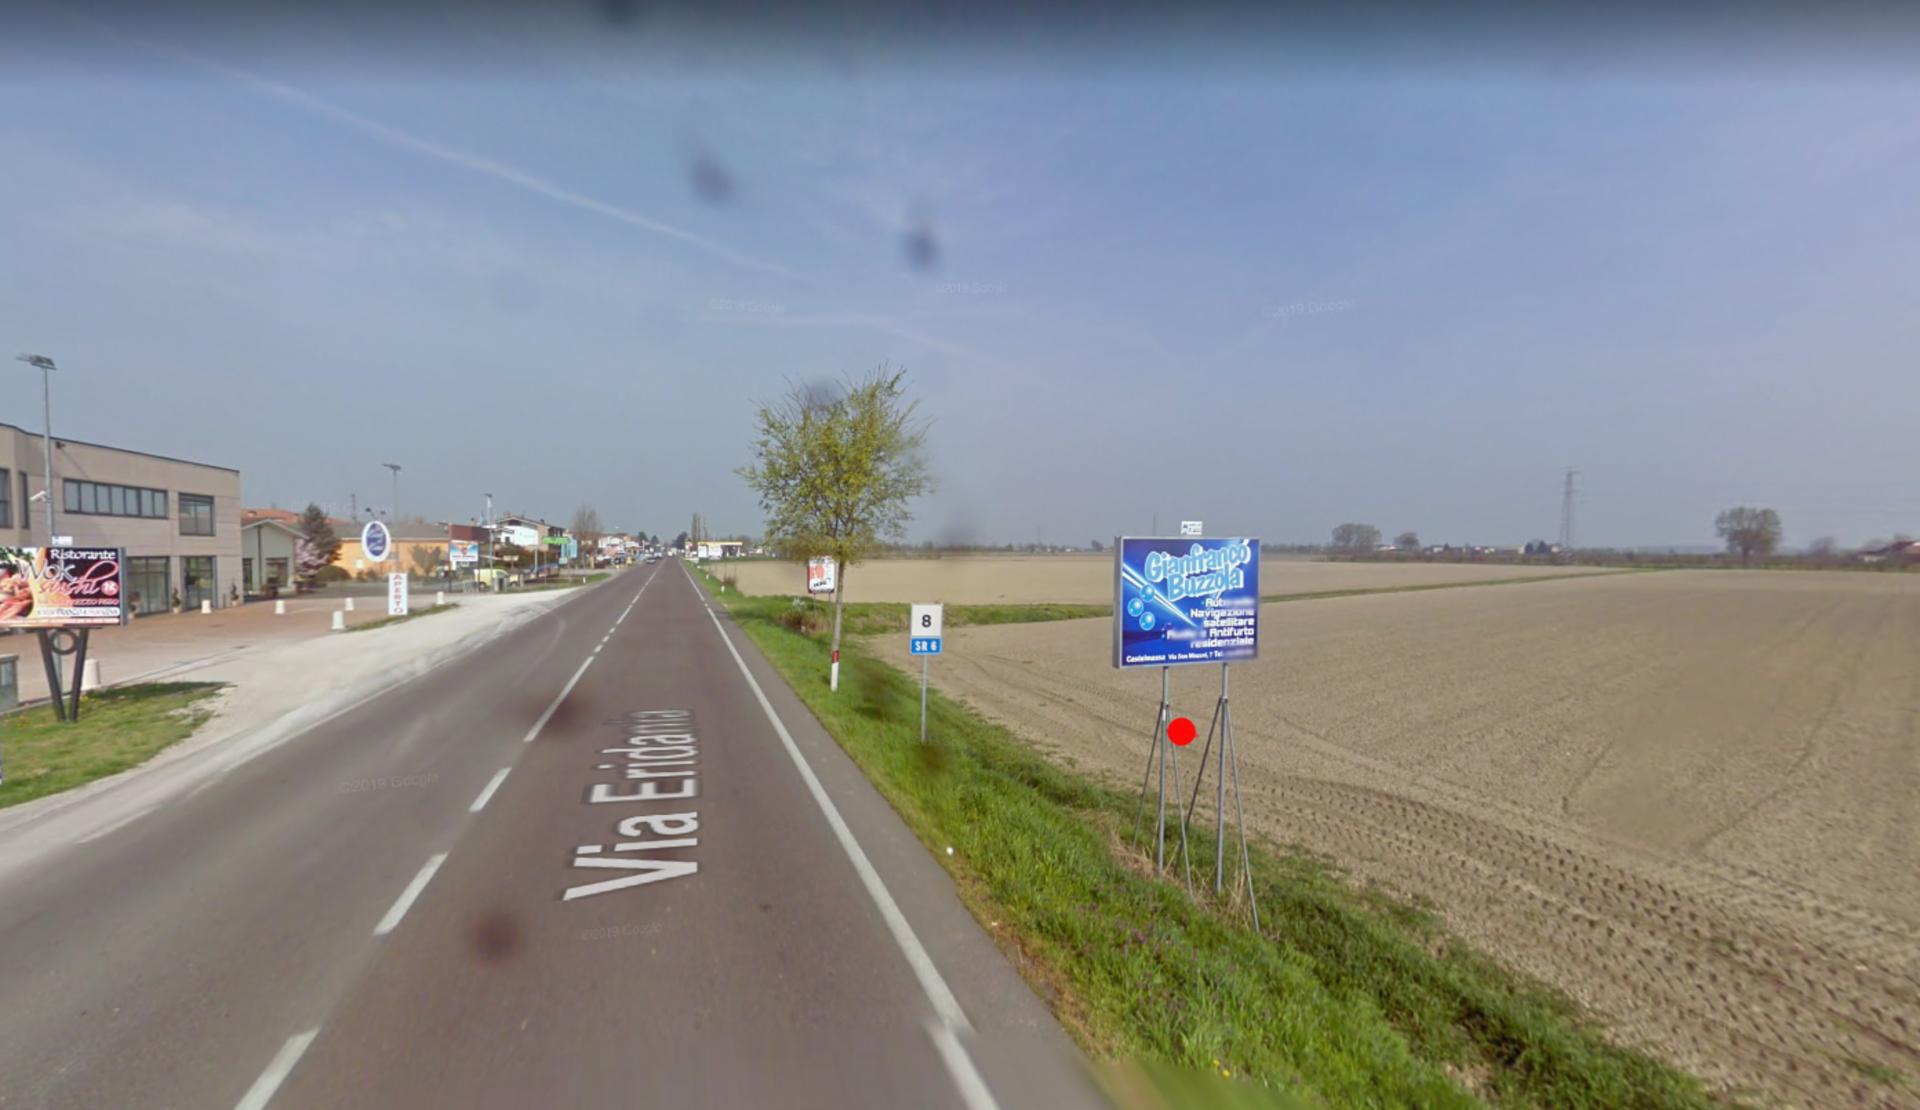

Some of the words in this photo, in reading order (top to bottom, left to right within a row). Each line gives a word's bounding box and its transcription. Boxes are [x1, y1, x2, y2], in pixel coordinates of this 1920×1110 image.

[50, 548, 116, 560] Ristorante
[1145, 543, 1251, 582] Gianfranco
[17, 559, 78, 581] Wok
[1167, 564, 1244, 601] Buzzola
[921, 614, 932, 628] 8
[1190, 609, 1254, 621] Navigazione
[1203, 618, 1254, 628] satellitare
[1209, 627, 1254, 637] Antifurto
[915, 640, 928, 651] SR
[930, 640, 938, 651] 6
[1190, 637, 1254, 648] residenziale
